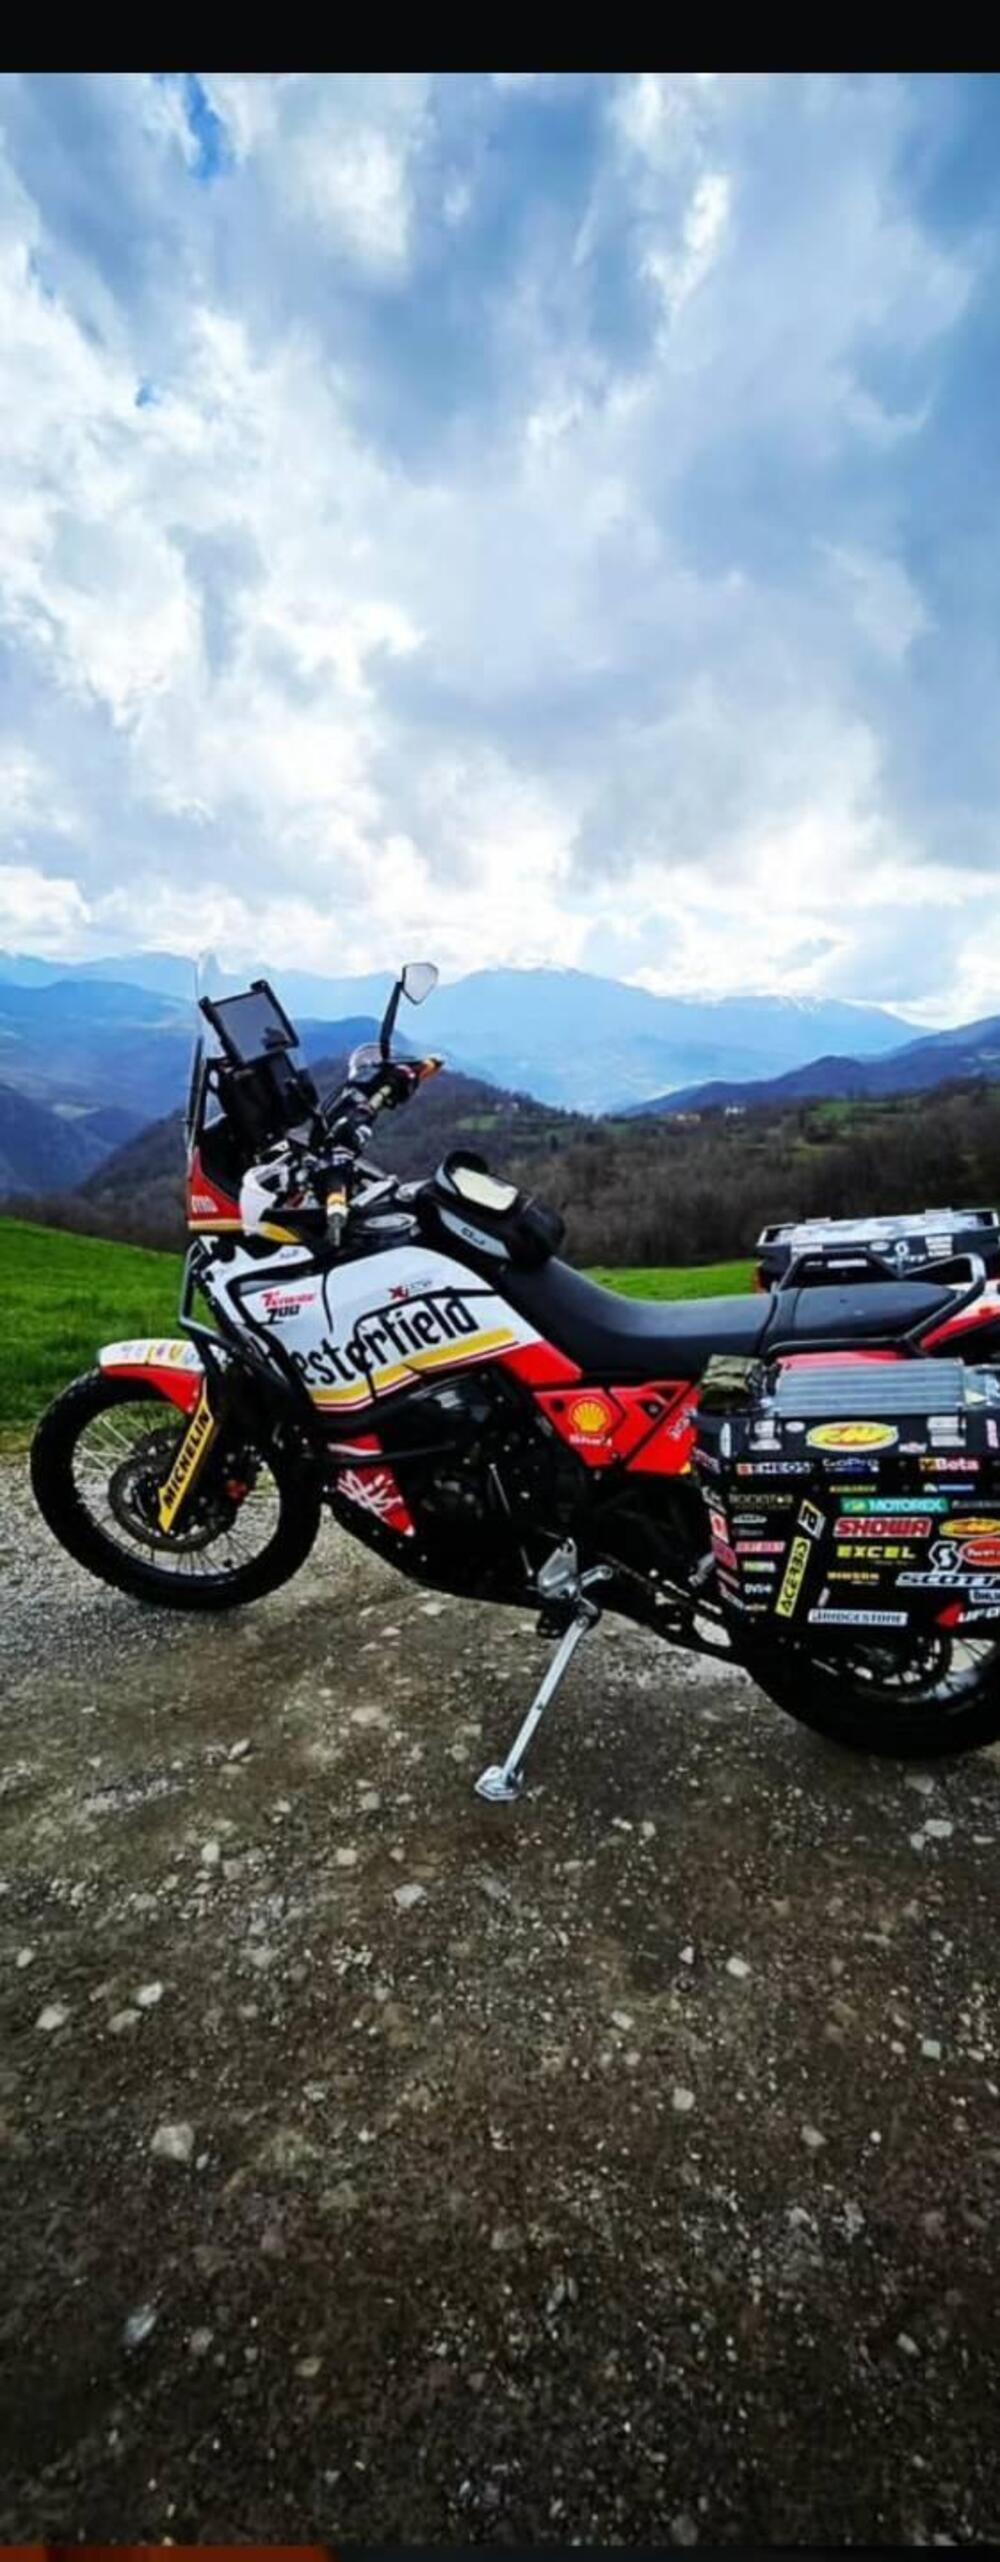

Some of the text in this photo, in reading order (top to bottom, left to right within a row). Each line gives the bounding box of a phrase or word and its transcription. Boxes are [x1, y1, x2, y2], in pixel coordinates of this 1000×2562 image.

[162, 1409, 209, 1509] MICHELIN
[935, 1457, 979, 1471] Beta
[867, 1498, 943, 1512] MOTOREX
[836, 1519, 929, 1536] SHOWA
[837, 1545, 915, 1558] EXCEL
[778, 1541, 808, 1614] ACERBIS
[898, 1573, 1000, 1586] SCOTT
[810, 1611, 901, 1623] BRIDGESTONE
